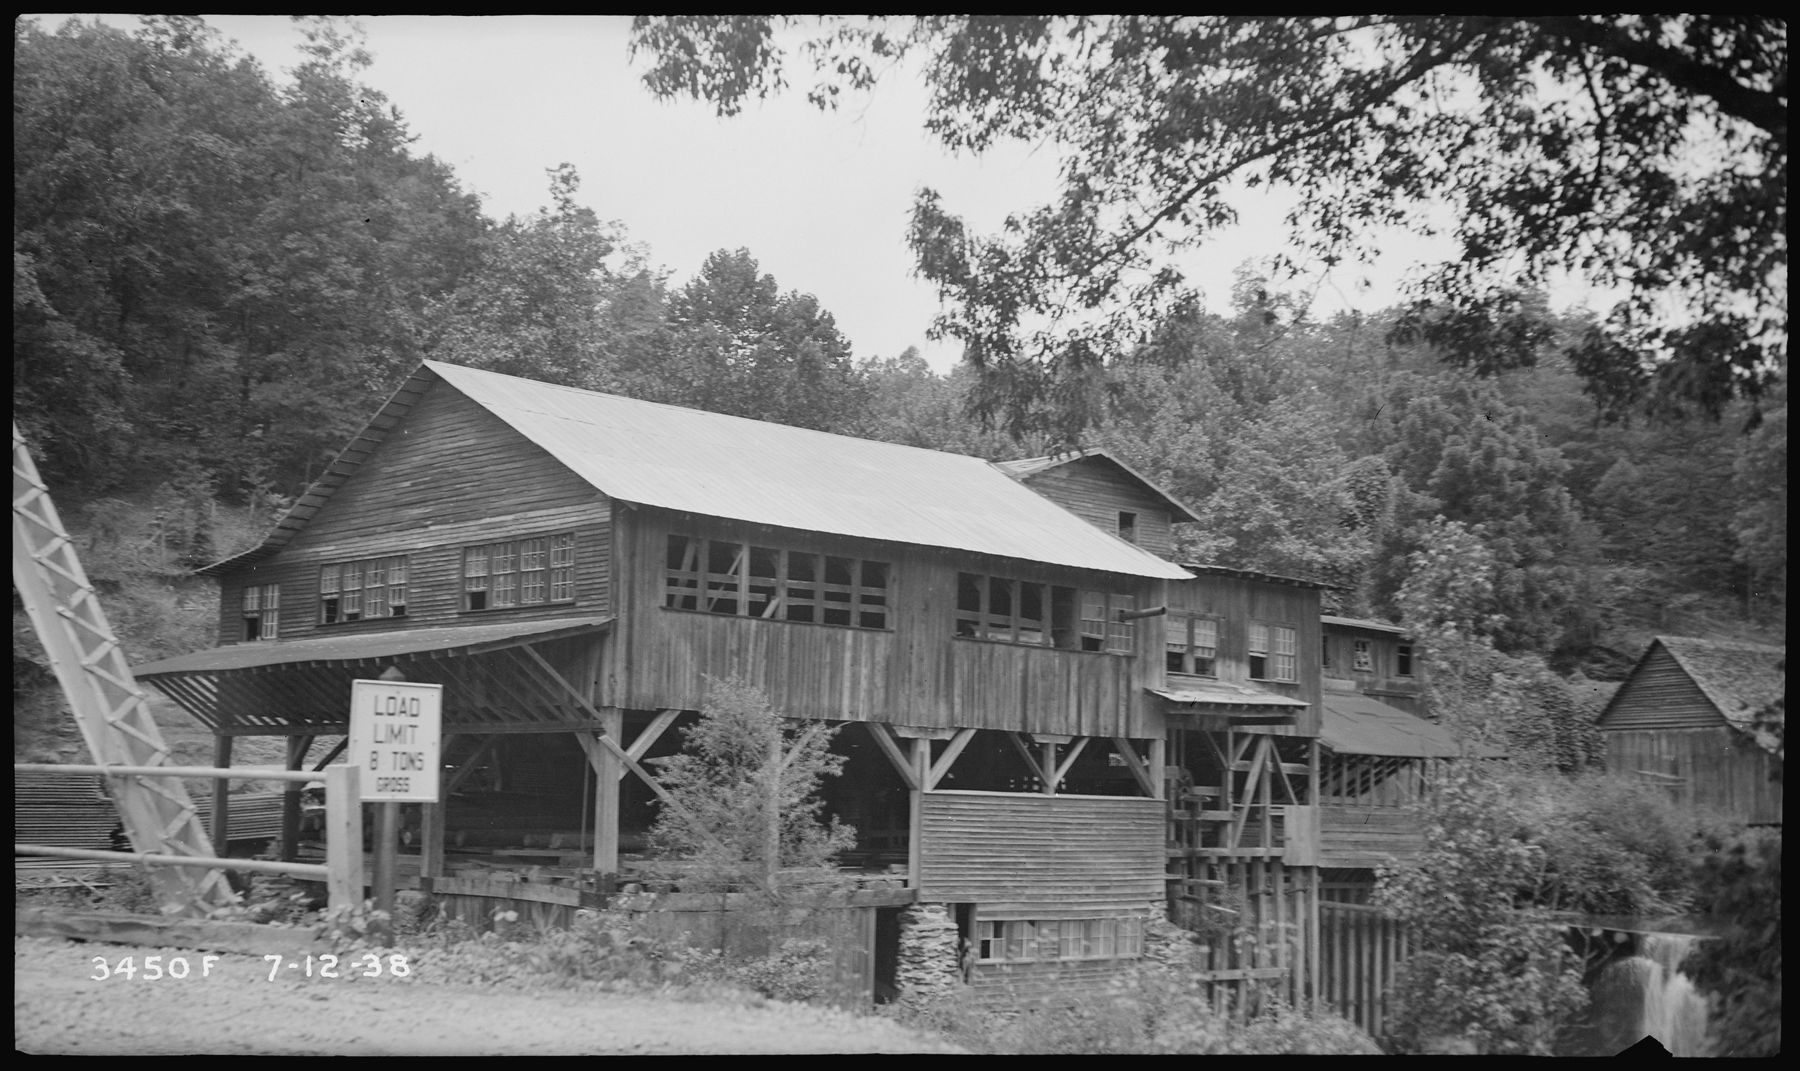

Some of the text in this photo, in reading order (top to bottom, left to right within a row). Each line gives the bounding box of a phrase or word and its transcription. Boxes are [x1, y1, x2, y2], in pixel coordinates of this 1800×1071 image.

[374, 695, 420, 718] LOAD
[373, 723, 419, 745] LIMIT
[370, 750, 424, 771] 8 TONS
[376, 776, 410, 793] GROSS
